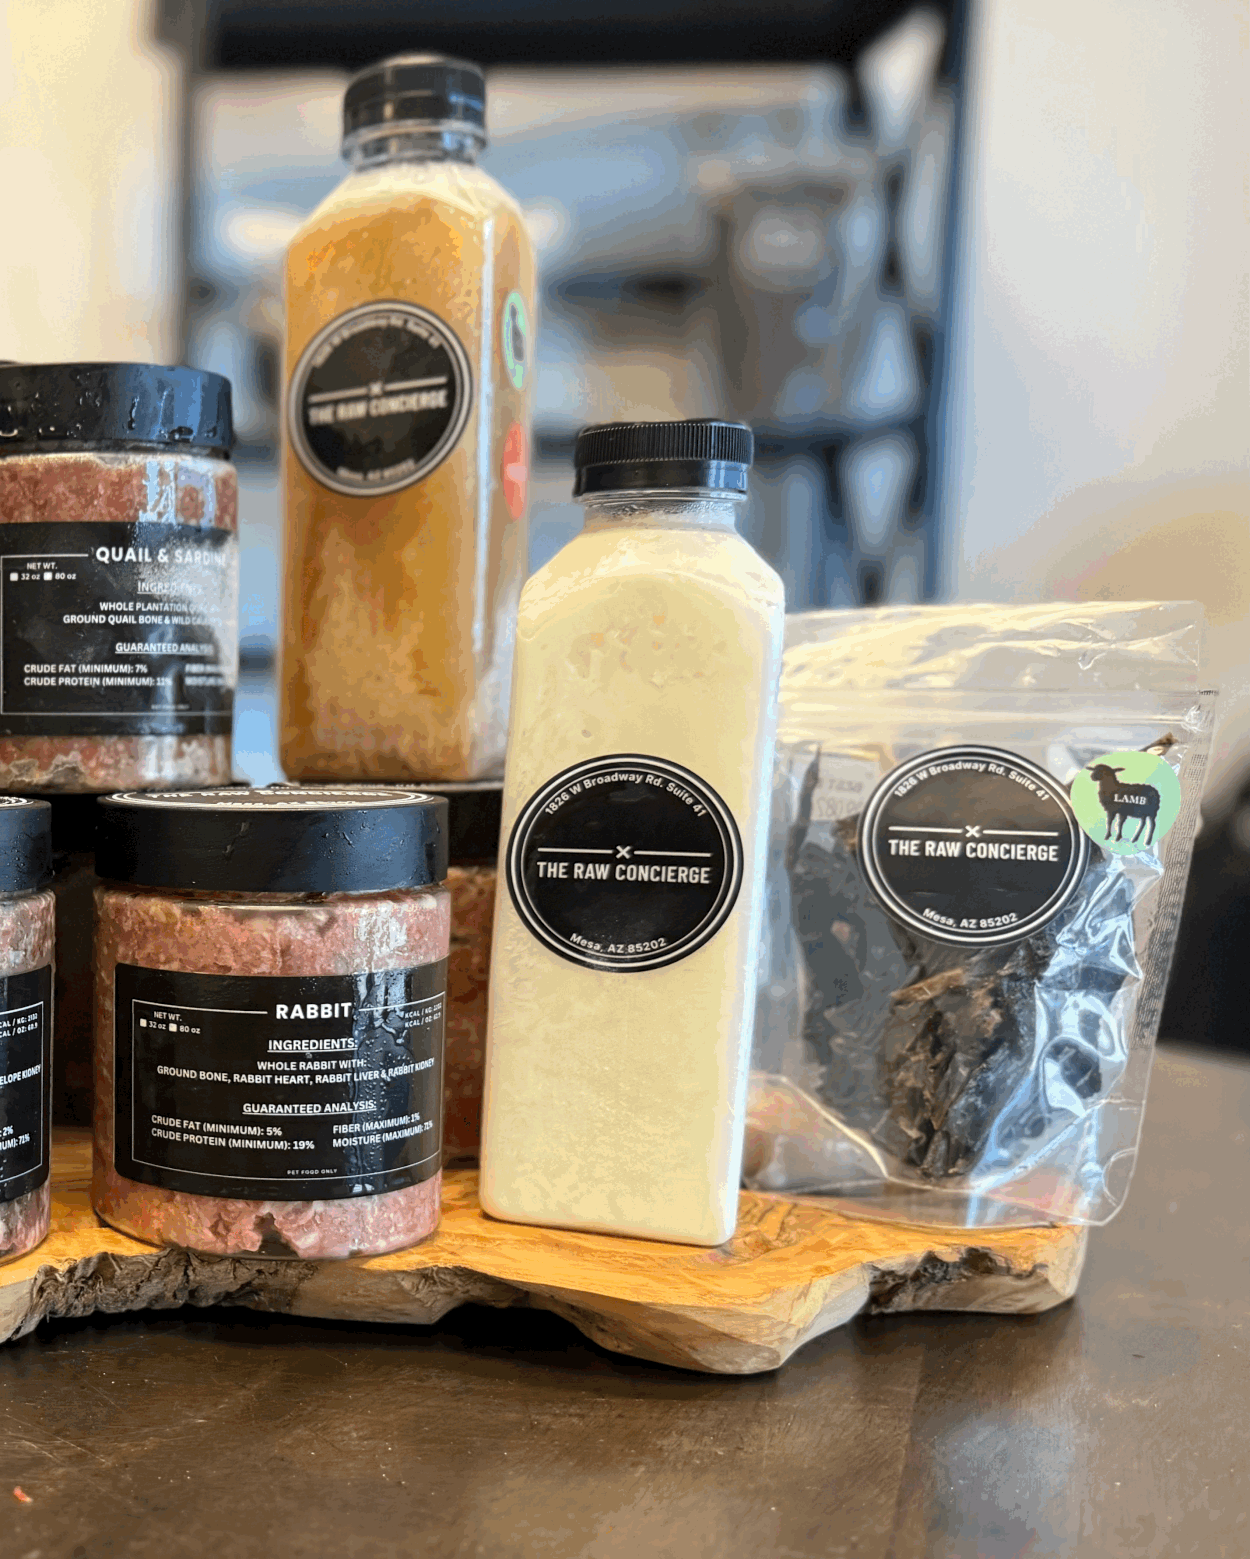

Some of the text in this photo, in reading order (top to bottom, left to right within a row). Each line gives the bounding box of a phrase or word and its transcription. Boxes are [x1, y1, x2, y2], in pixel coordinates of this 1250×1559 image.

[96, 547, 151, 563] QUAIL
[158, 548, 168, 562] &
[100, 602, 134, 611] WHOLE
[63, 615, 106, 624] GROUND
[108, 615, 137, 624] QUAIL
[139, 615, 162, 624] BONE
[164, 616, 170, 624] &
[115, 642, 178, 652] GUARANTEED
[24, 664, 147, 674] CRUDE FAT (MINIMUM): 7%
[894, 762, 1050, 801] 1826 W Broadway Rd. Suite 41
[545, 772, 707, 817] 1826 W Broadway Rd. Suite 41
[1114, 794, 1147, 804] LAMB
[888, 840, 1058, 861] THE RAW CONCIERGE
[537, 862, 711, 884] THE RAW CONCIERGE
[922, 908, 1018, 928] Mesa, AZ 85202
[607, 944, 623, 953] AZ
[628, 937, 666, 953] 85202
[276, 1003, 352, 1019] RABBIT
[268, 1038, 357, 1051] INGREDIENTS:
[157, 1058, 435, 1085] GROUND BONE, RABBIT HEART, RABBIT LIVER & RABBIT KIDNEY
[257, 1058, 367, 1071] WHOLE RABBIT WITH:
[22, 1065, 41, 1081] KIDNEY
[243, 1099, 376, 1114] GUARANTEED ANALYSIS:
[152, 1115, 282, 1136] CRUDE FAT (MINIMUM): 5%
[152, 1128, 314, 1150] CRUDE PROTEIN (MINIMUM): 19%
